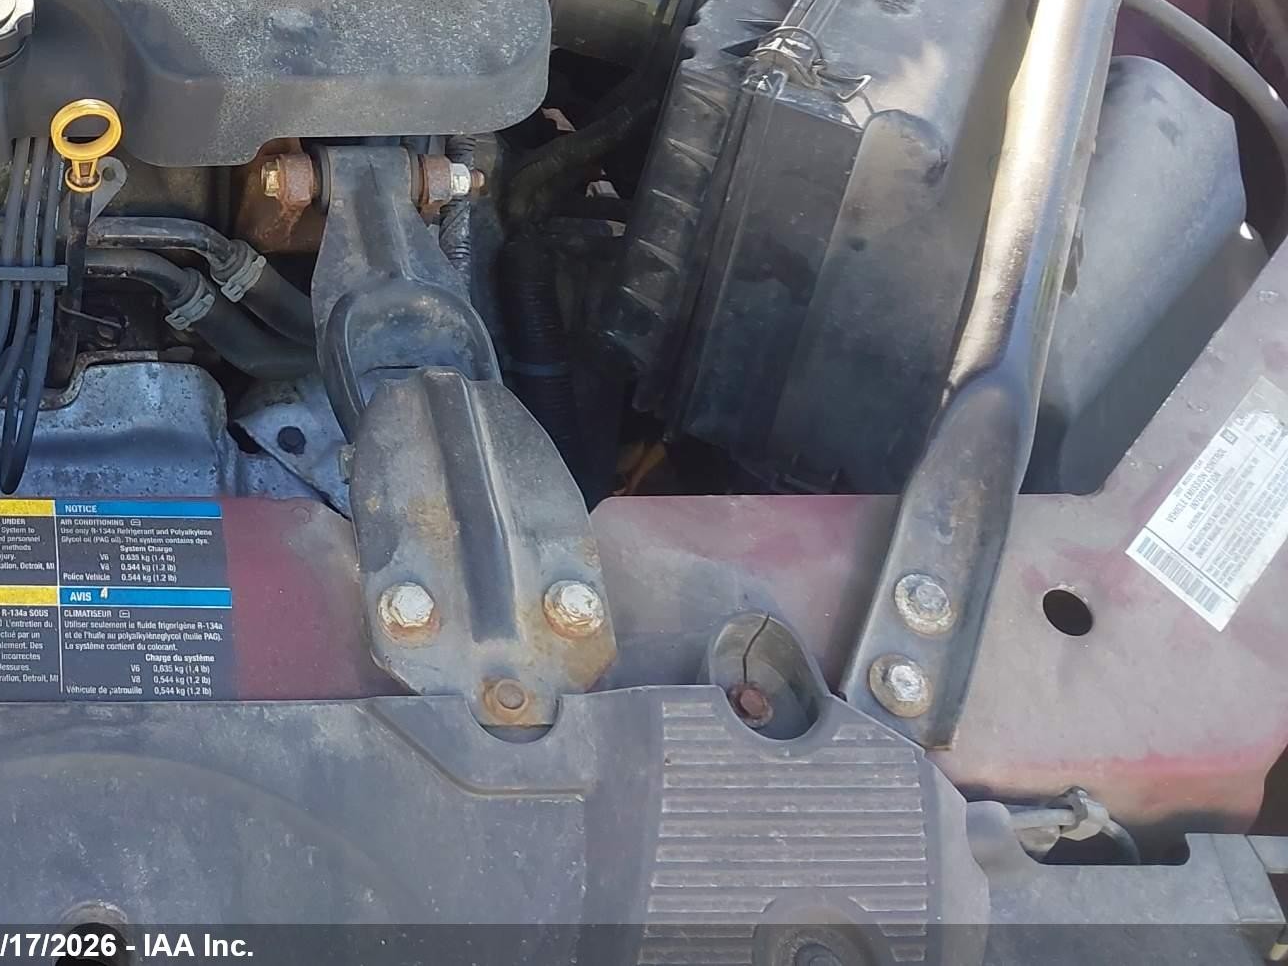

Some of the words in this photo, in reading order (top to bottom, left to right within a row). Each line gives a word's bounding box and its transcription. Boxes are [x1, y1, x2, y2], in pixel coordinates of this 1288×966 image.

[65, 505, 98, 513] NOTICE
[120, 545, 146, 553] System
[148, 545, 173, 553] Charge
[20, 562, 45, 571] Detroit,
[70, 592, 92, 601] AVIS
[29, 609, 49, 617] SOUS
[64, 610, 112, 618] CLIMATISEUR
[44, 620, 53, 628] du
